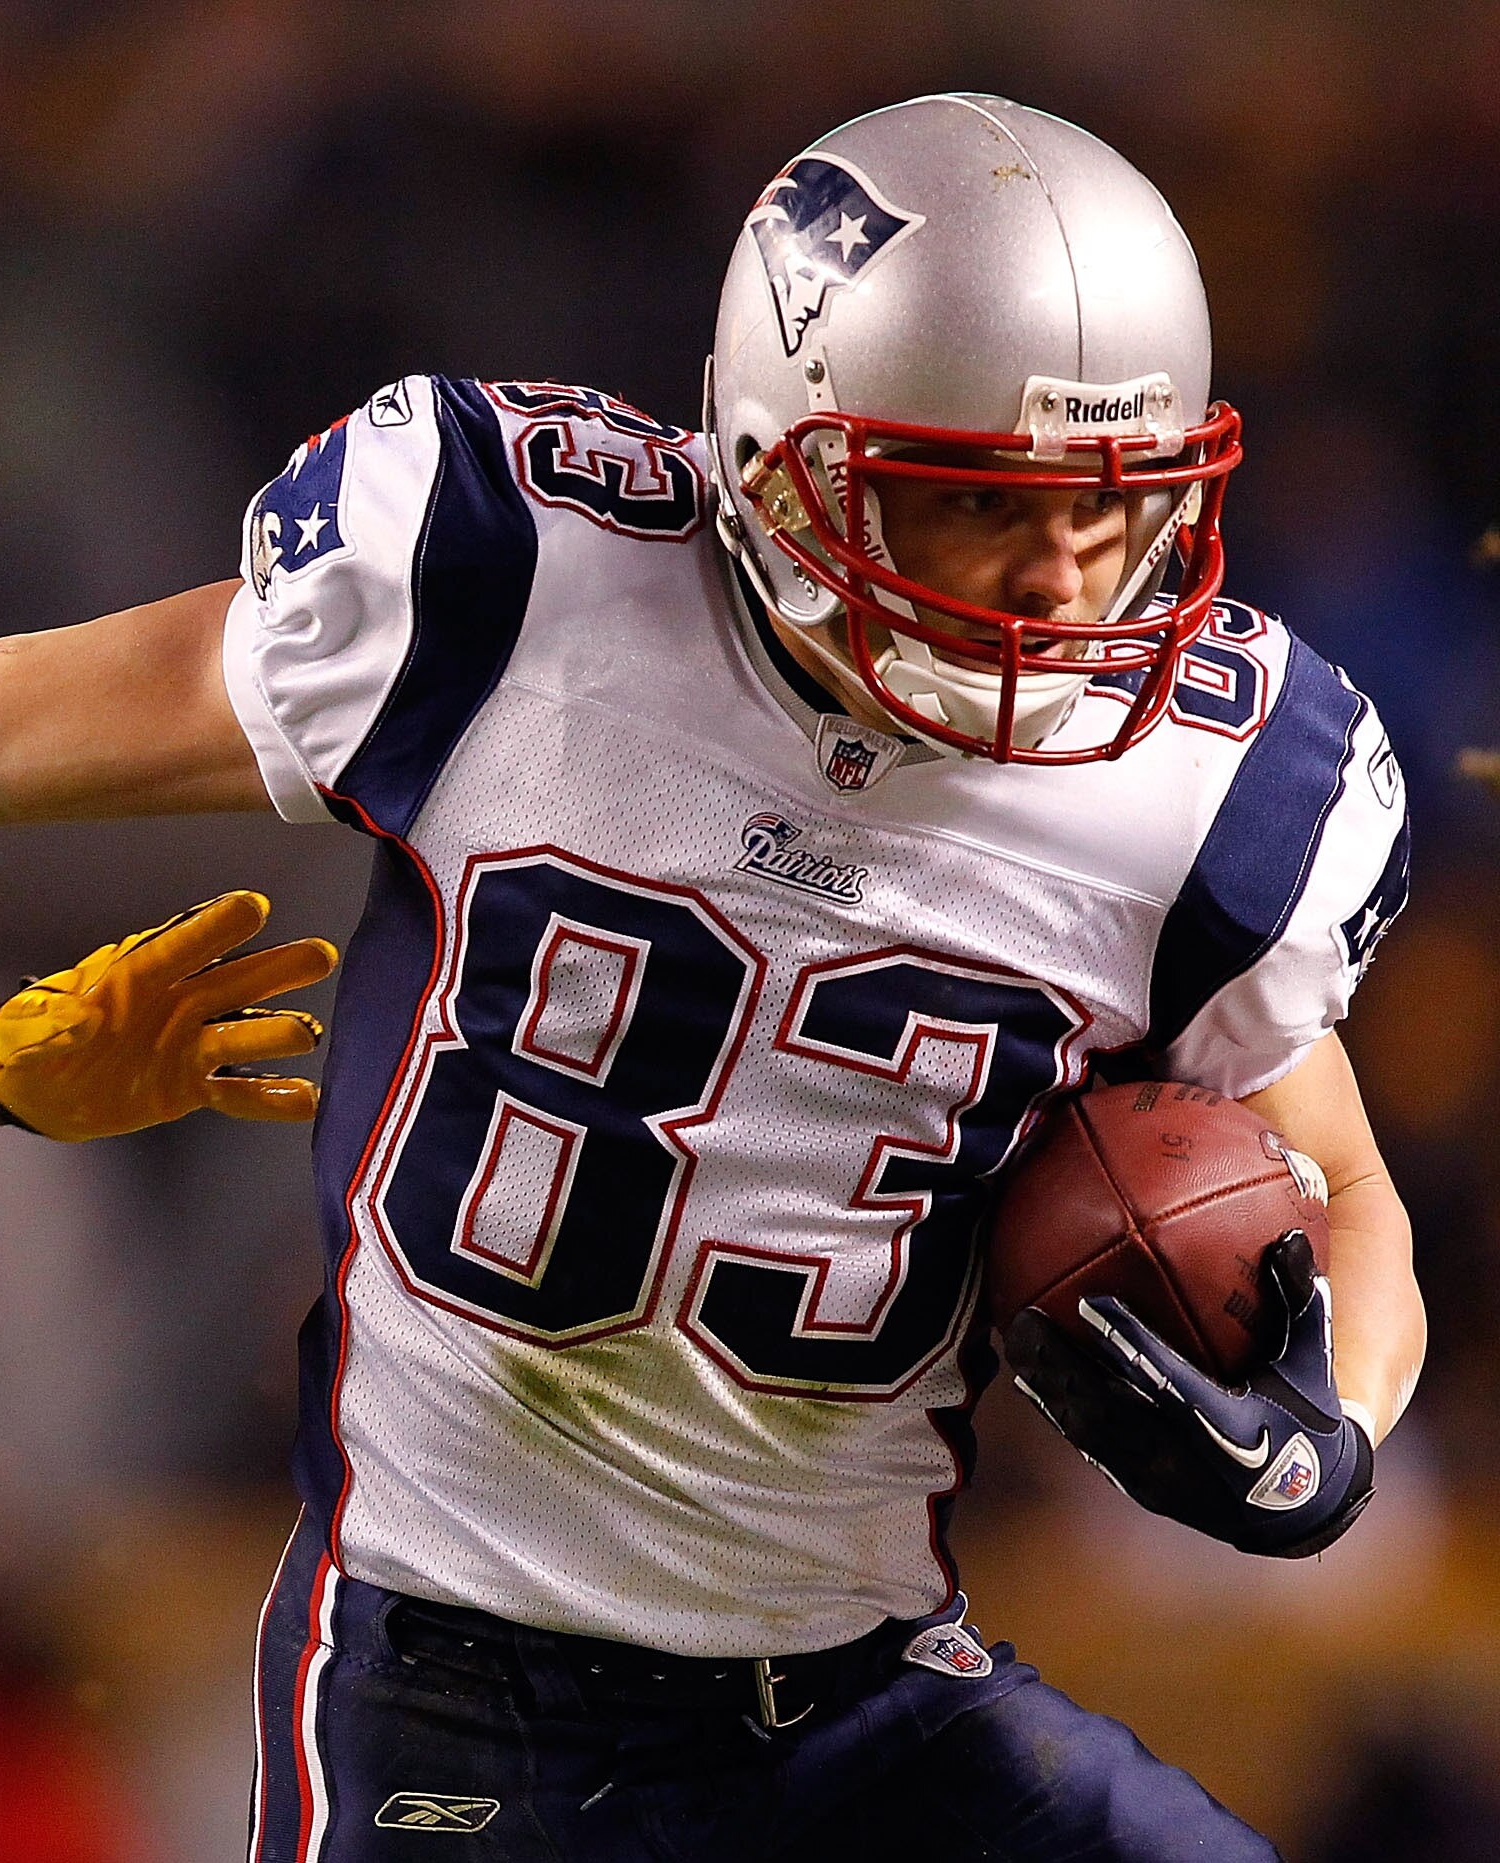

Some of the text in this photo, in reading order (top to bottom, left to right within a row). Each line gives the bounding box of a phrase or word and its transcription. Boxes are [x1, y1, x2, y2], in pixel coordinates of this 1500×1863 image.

[1065, 393, 1145, 423] Riddell
[827, 462, 885, 560] Riell
[830, 757, 867, 786] NFL
[734, 827, 868, 904] Patriots
[369, 844, 1095, 1403] 83
